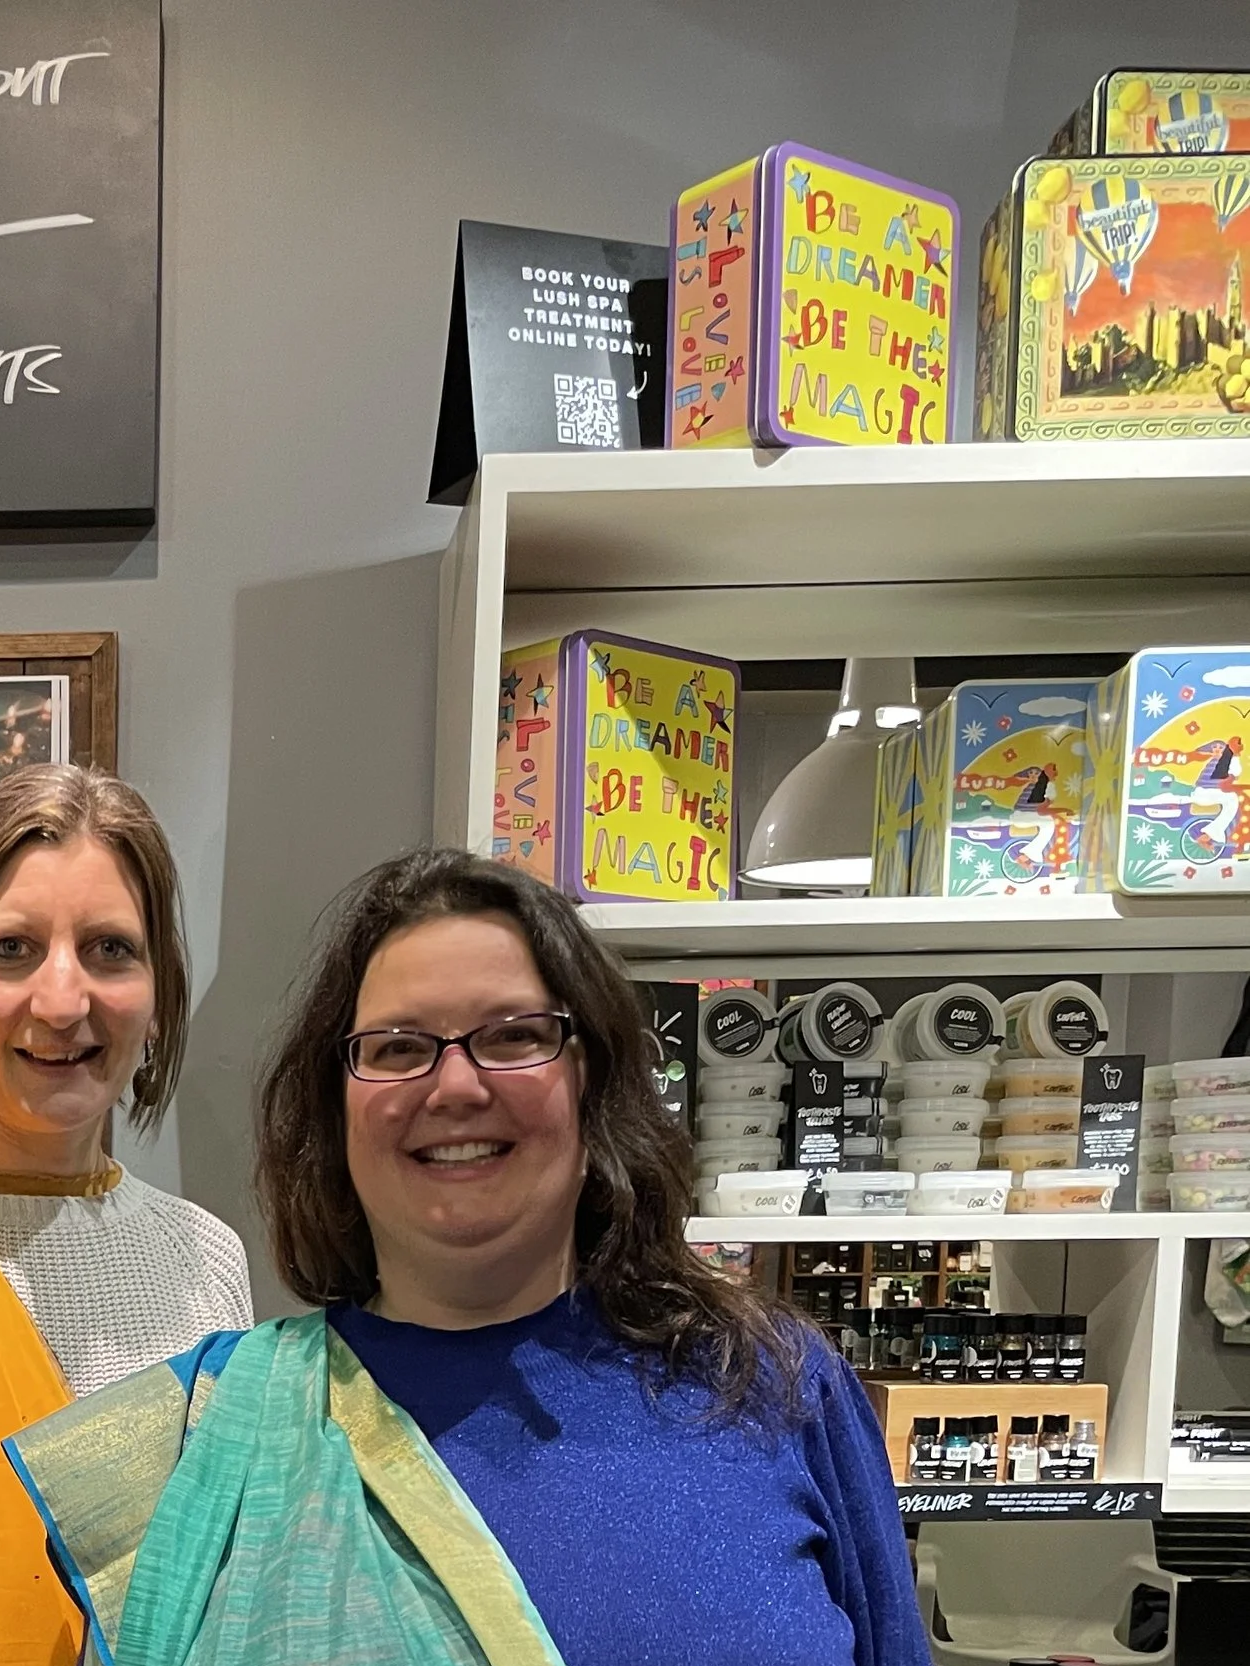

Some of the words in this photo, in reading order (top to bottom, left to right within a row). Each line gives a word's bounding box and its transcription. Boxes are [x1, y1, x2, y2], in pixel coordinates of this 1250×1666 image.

[1159, 114, 1221, 139] beautiful
[805, 190, 861, 236] BE
[884, 216, 912, 256] A
[1079, 199, 1151, 229] beautiful
[1102, 222, 1140, 250] TRIP!
[522, 266, 573, 286] BOOK
[580, 273, 630, 293] YOUR
[787, 236, 946, 319] DREAMER
[533, 288, 580, 307] LUSH
[587, 295, 623, 313] SPA
[524, 308, 634, 334] TREATMENT
[508, 327, 577, 347] ONLINE
[584, 335, 651, 357] TODAY!
[801, 299, 848, 350] BE
[869, 315, 927, 380] THE
[790, 363, 936, 445] MAGIC
[606, 668, 654, 709] BE
[674, 684, 699, 718] A
[590, 713, 730, 772] DREAMER
[1138, 752, 1187, 765] LUSH
[960, 778, 1006, 790] LUSH
[602, 768, 643, 813] BE
[661, 776, 713, 829] THE
[592, 827, 721, 892] MAGIC
[717, 1010, 742, 1031] COOL
[950, 1008, 978, 1022] COOL
[755, 1196, 779, 1207] COOL
[899, 1492, 974, 1513] EYELINER
